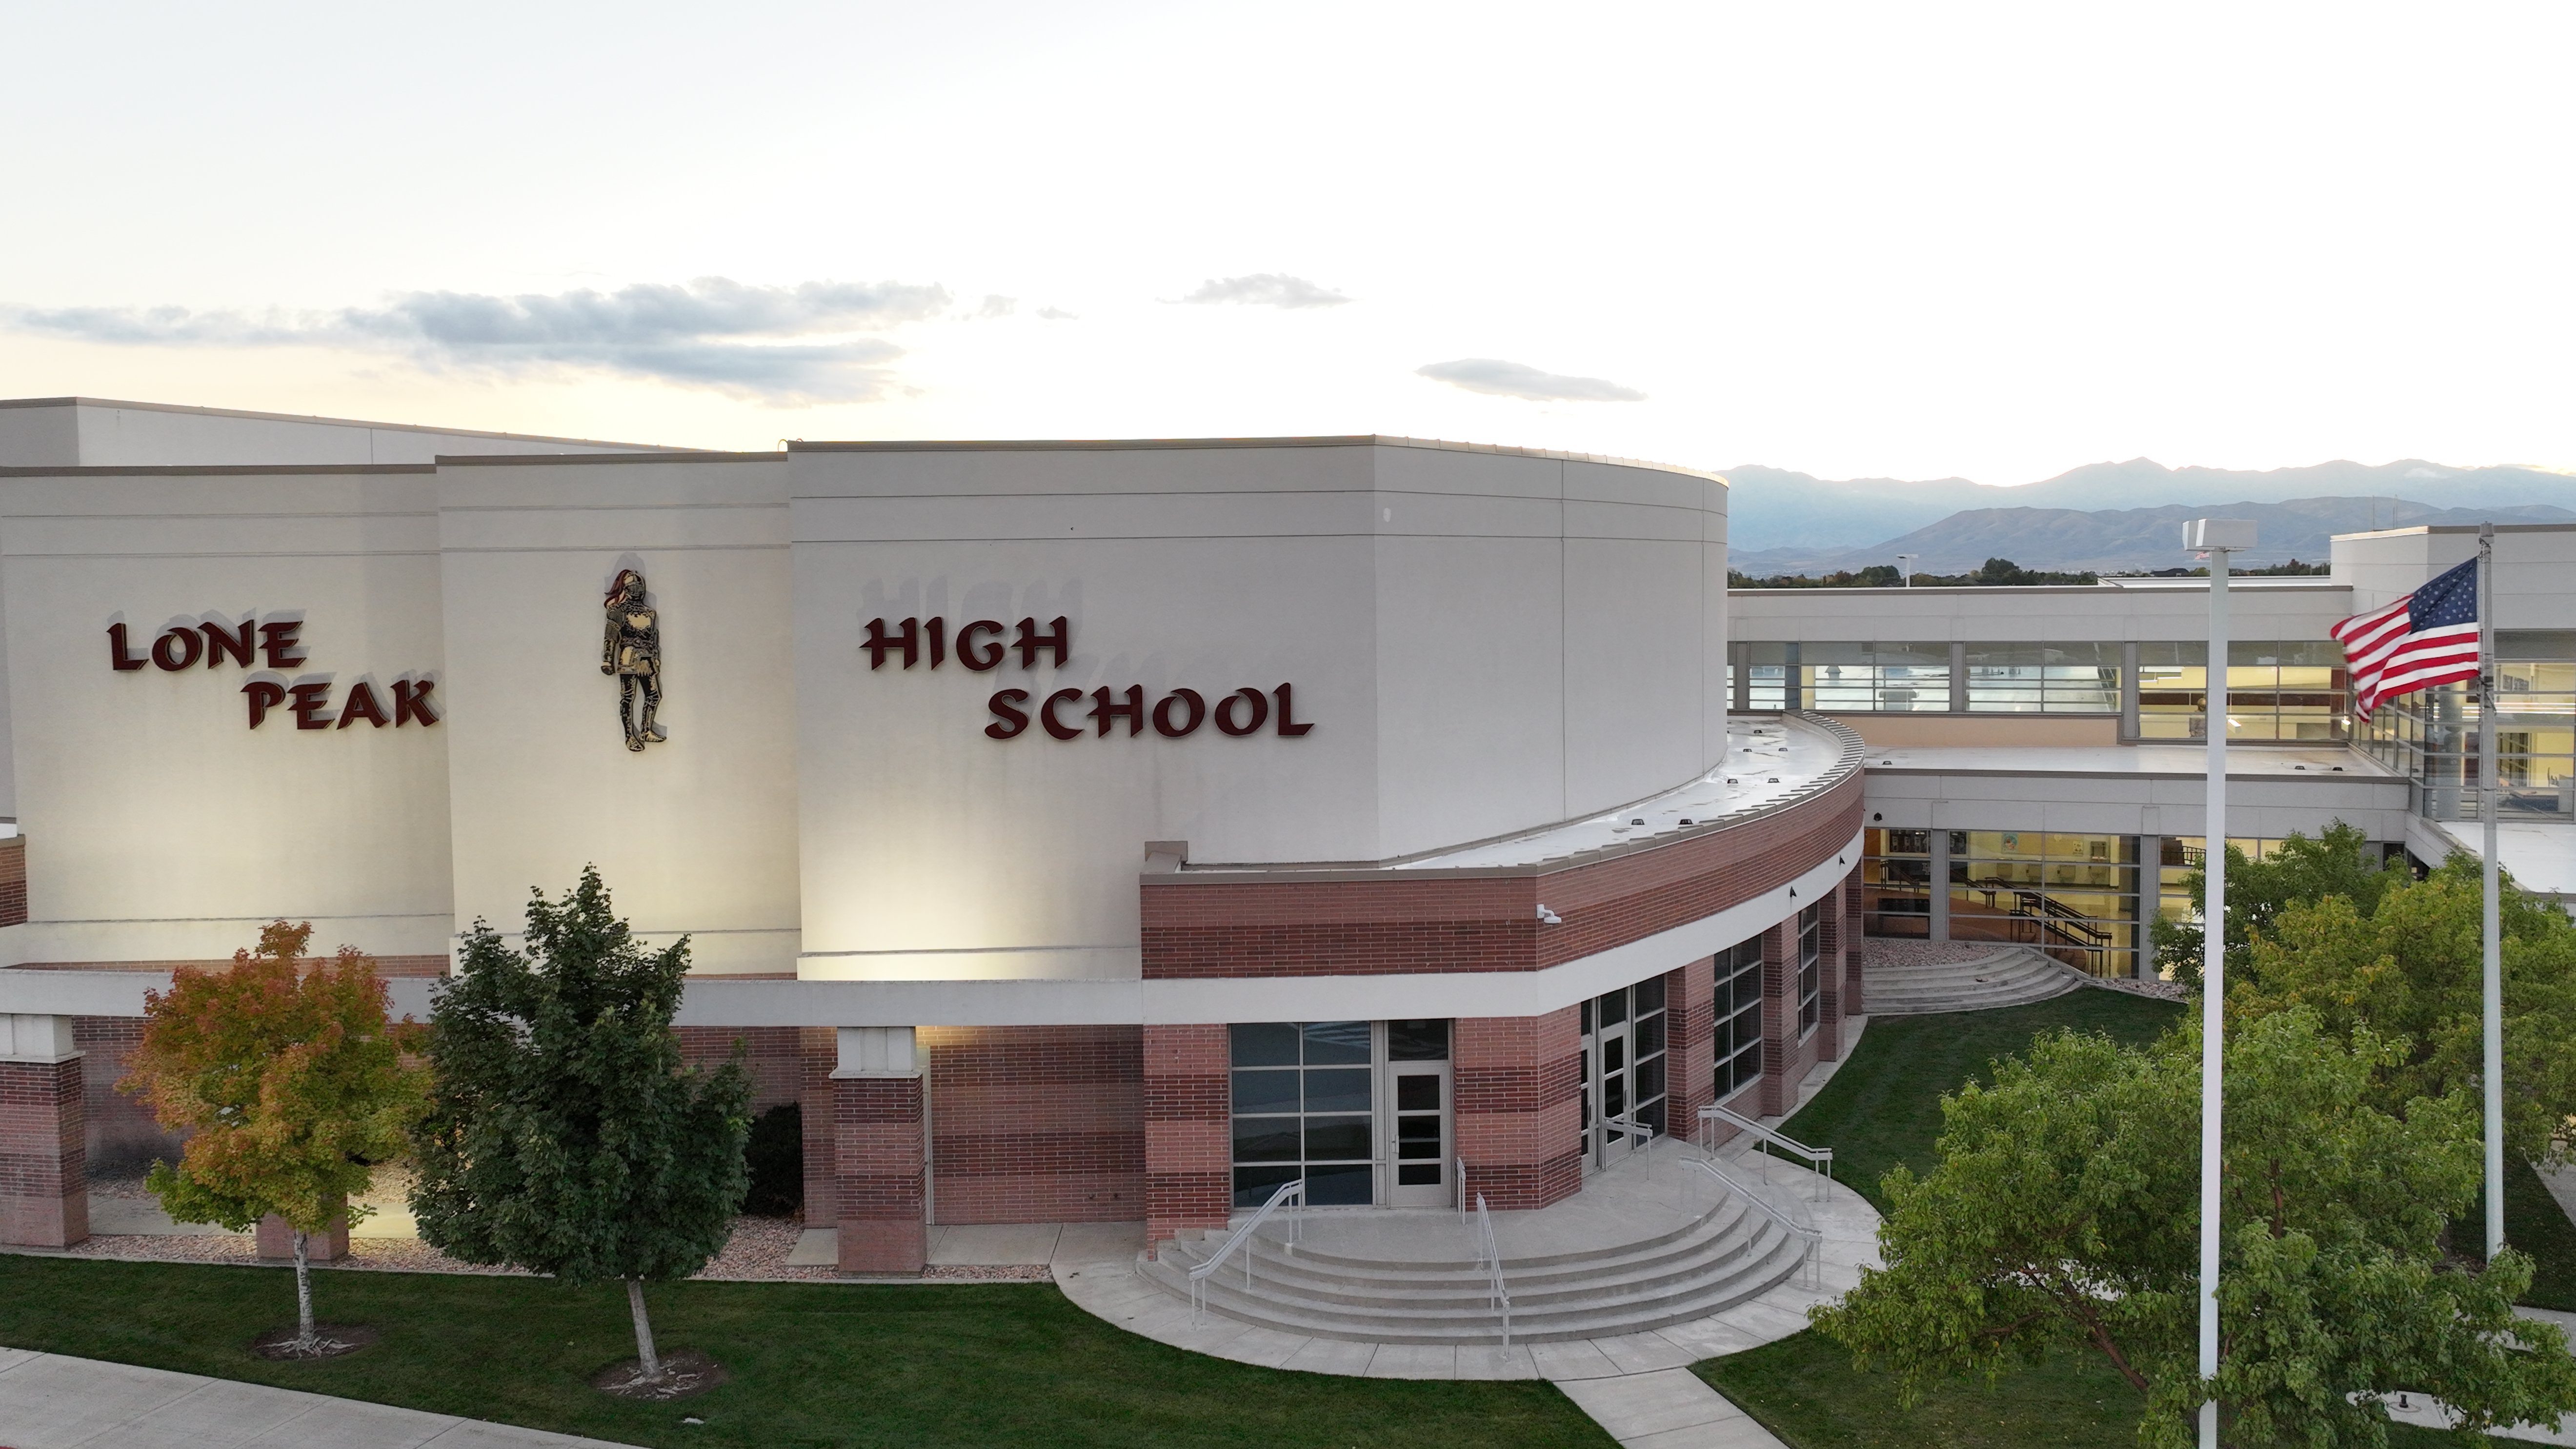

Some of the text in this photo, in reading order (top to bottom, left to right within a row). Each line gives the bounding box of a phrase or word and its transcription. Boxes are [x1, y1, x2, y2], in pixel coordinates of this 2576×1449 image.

[106, 619, 307, 671] LONE
[859, 616, 1070, 673] HIGH
[240, 680, 440, 730] PEAK
[984, 682, 1316, 741] SCHOOL
